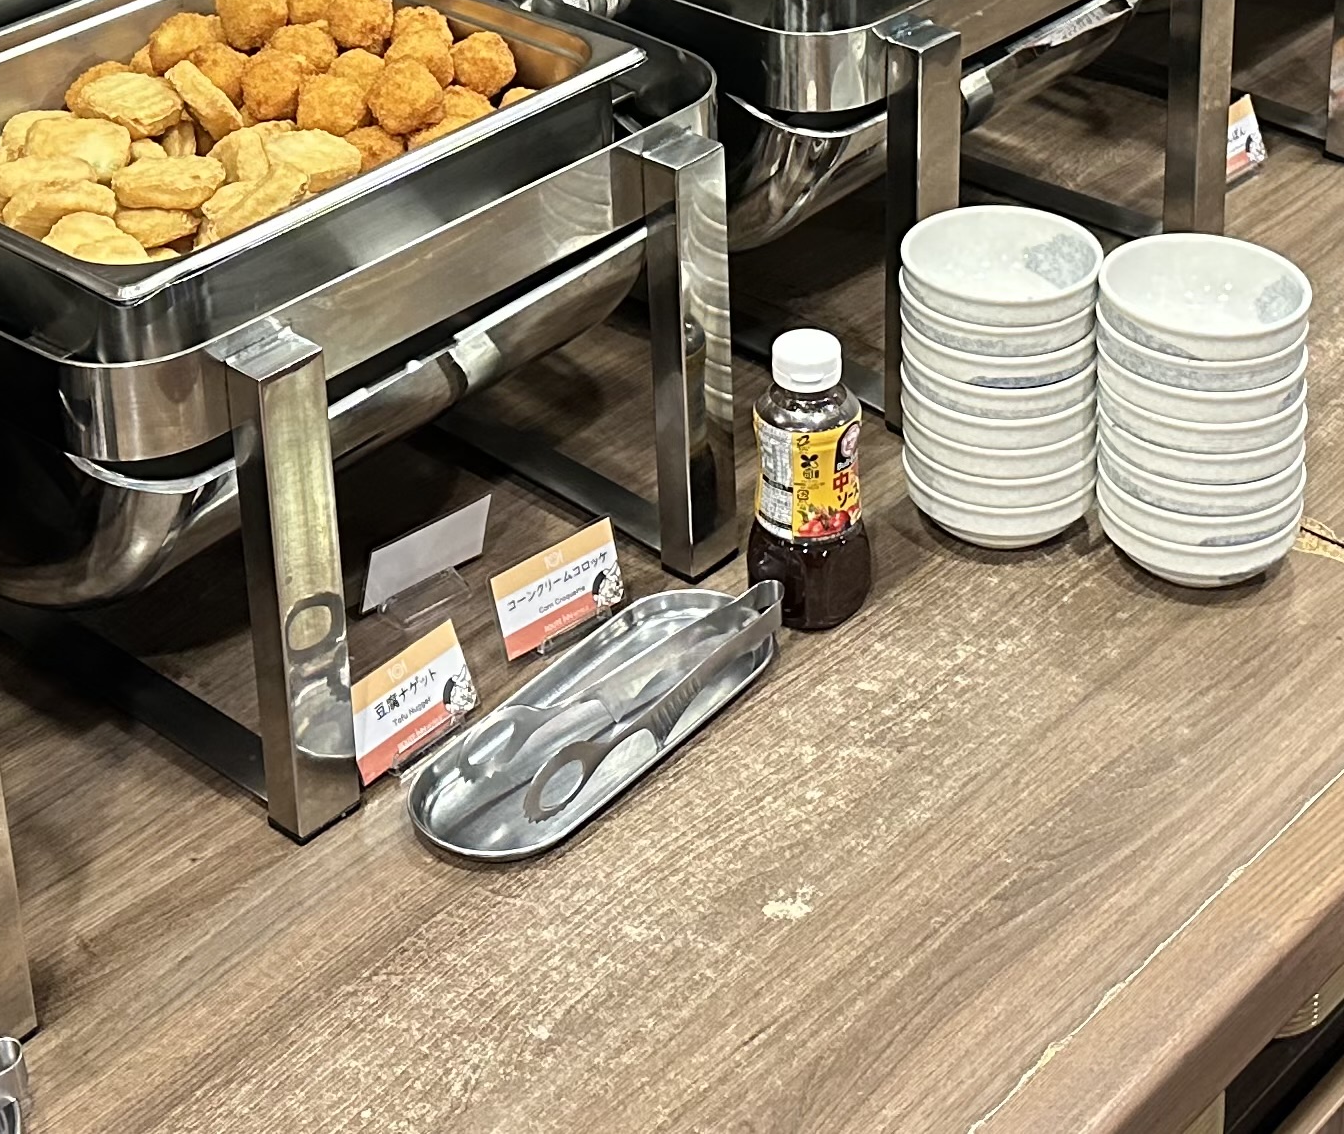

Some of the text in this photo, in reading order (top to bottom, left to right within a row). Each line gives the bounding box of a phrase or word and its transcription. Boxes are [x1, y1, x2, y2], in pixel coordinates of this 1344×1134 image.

[507, 550, 607, 612] コーンクリームコロッケ
[373, 668, 437, 721] 豆腐ナゲット
[392, 713, 409, 727] Tofu
